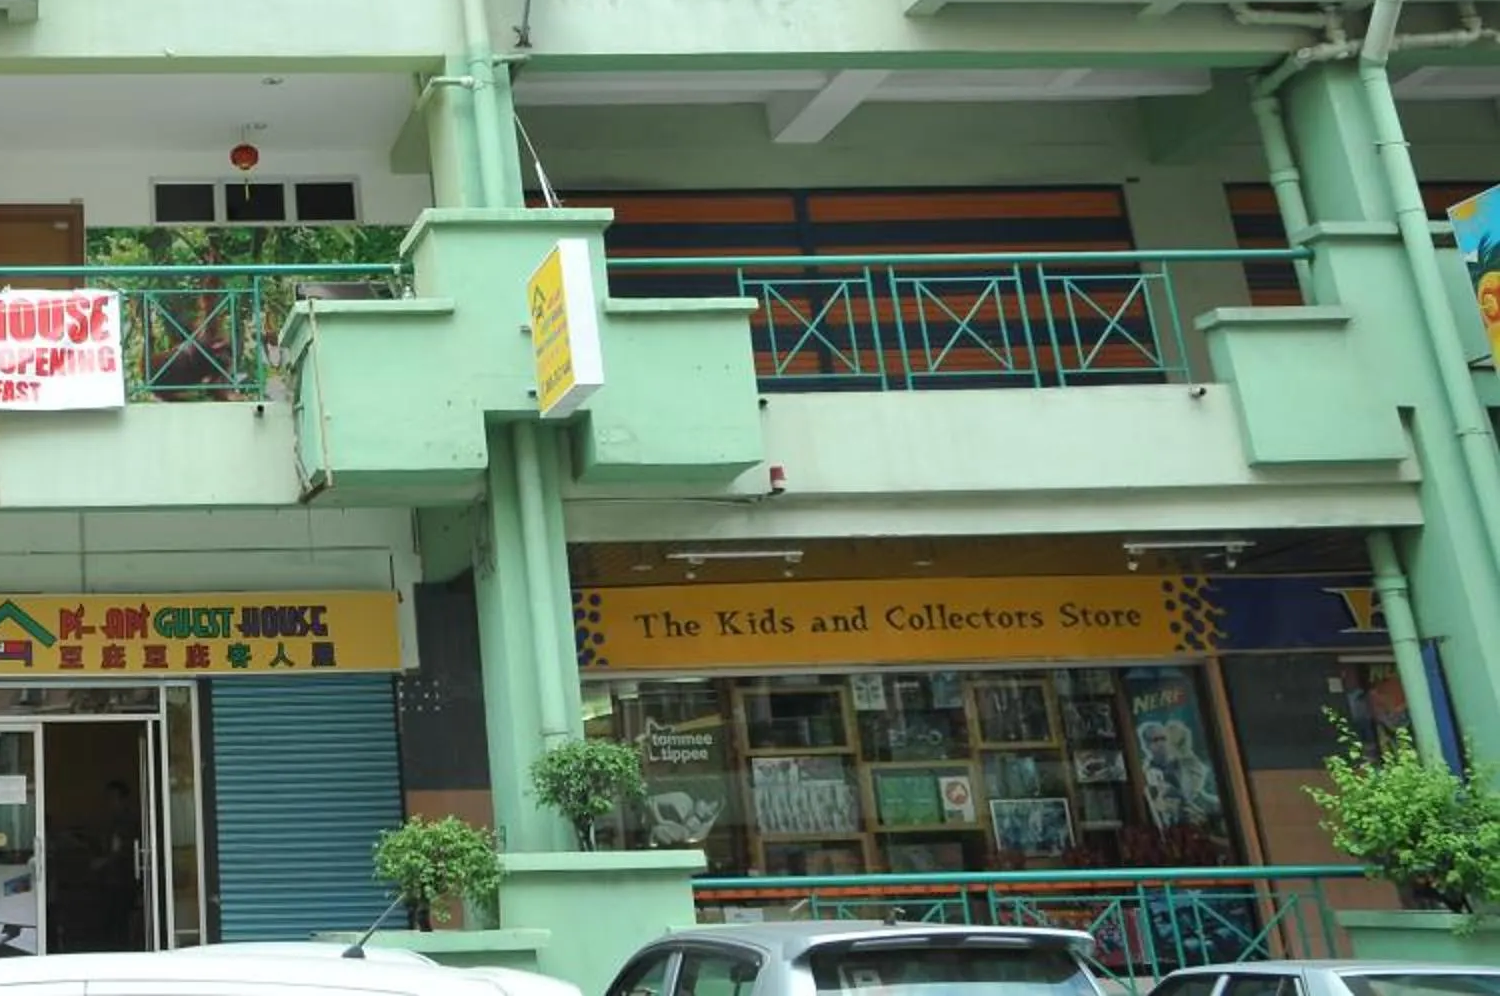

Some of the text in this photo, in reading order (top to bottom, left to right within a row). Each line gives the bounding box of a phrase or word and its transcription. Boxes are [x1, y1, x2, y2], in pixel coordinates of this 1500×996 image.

[635, 601, 1142, 639] The Kids and Collectors Store
[651, 732, 714, 746] tommee
[661, 746, 709, 764] tippee
